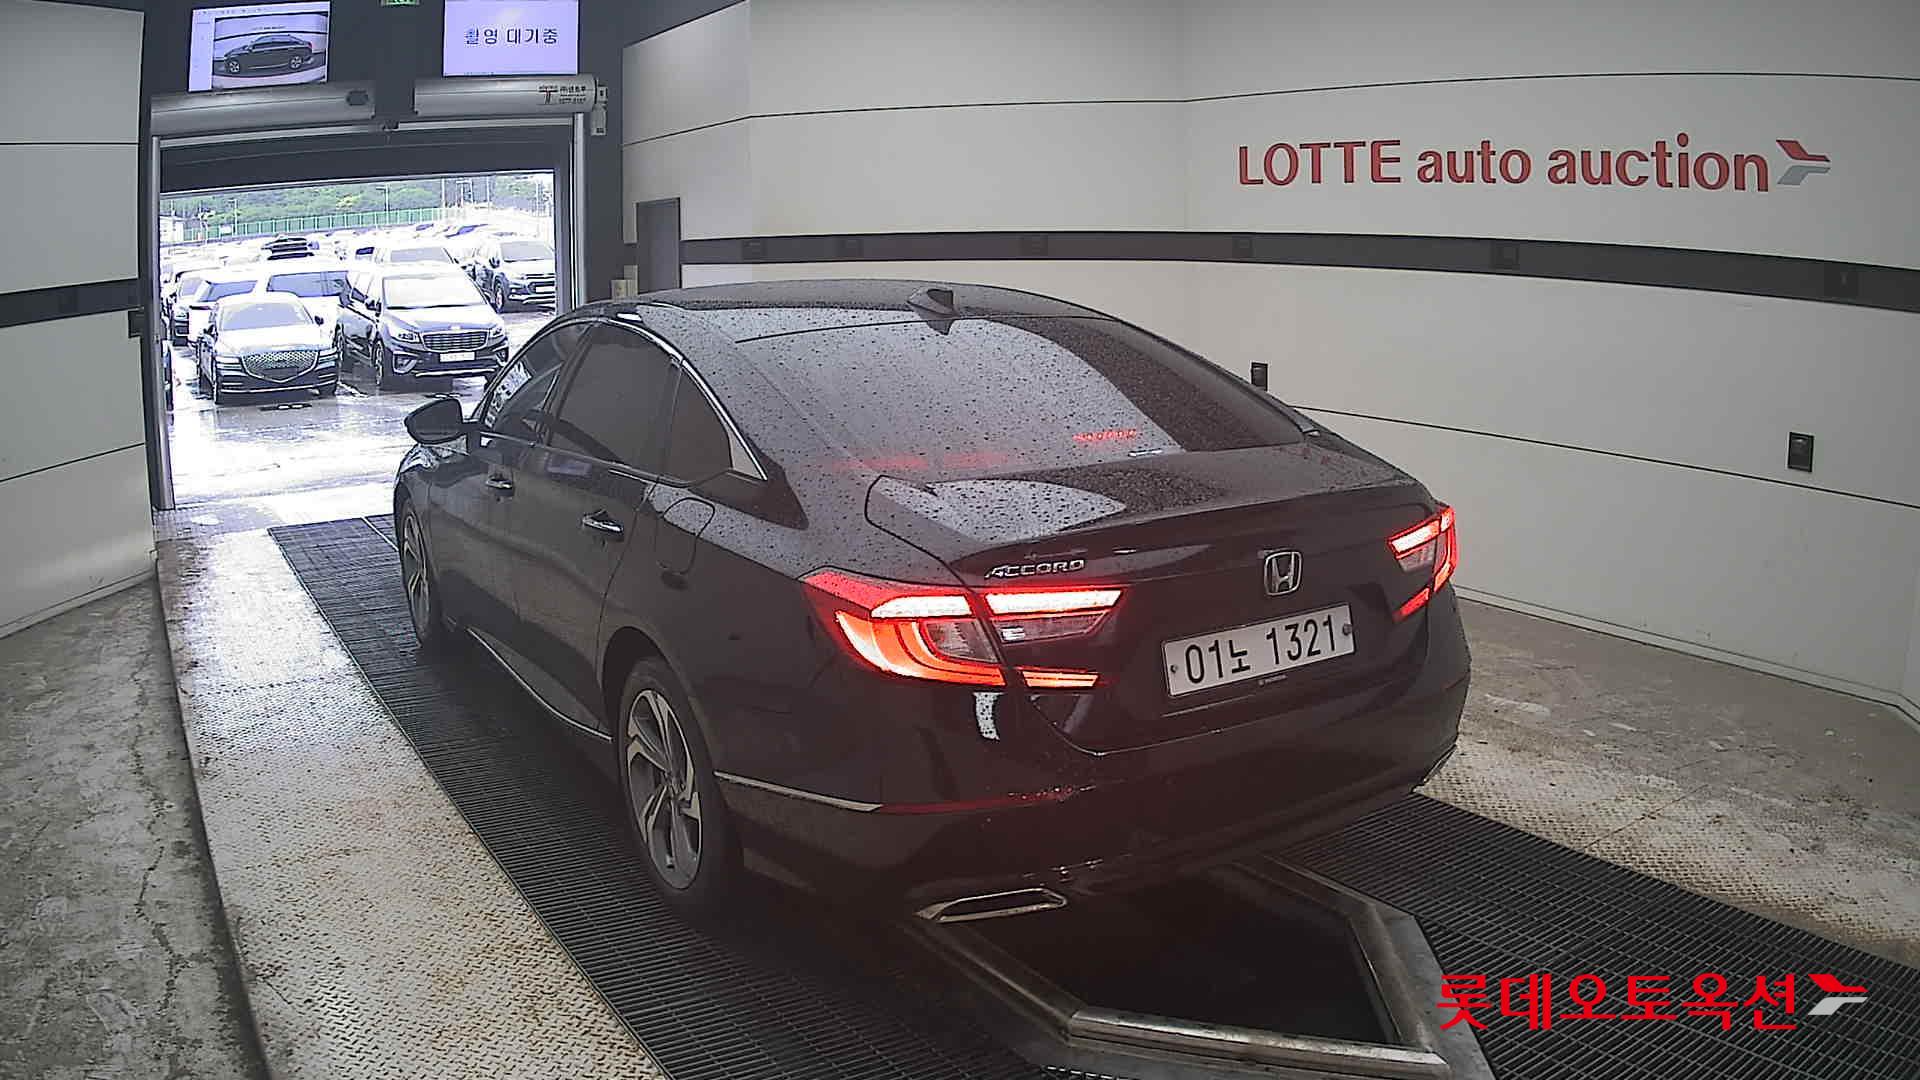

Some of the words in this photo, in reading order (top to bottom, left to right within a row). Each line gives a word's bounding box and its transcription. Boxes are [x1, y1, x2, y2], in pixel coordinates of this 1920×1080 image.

[506, 28, 558, 45] 대기중
[1238, 139, 1401, 186] LOTTE
[1416, 139, 1532, 185] auto
[1547, 132, 1770, 192] auction
[984, 558, 1085, 579] ACCORD
[1184, 639, 1251, 685] 01노
[1265, 614, 1338, 665] 1321
